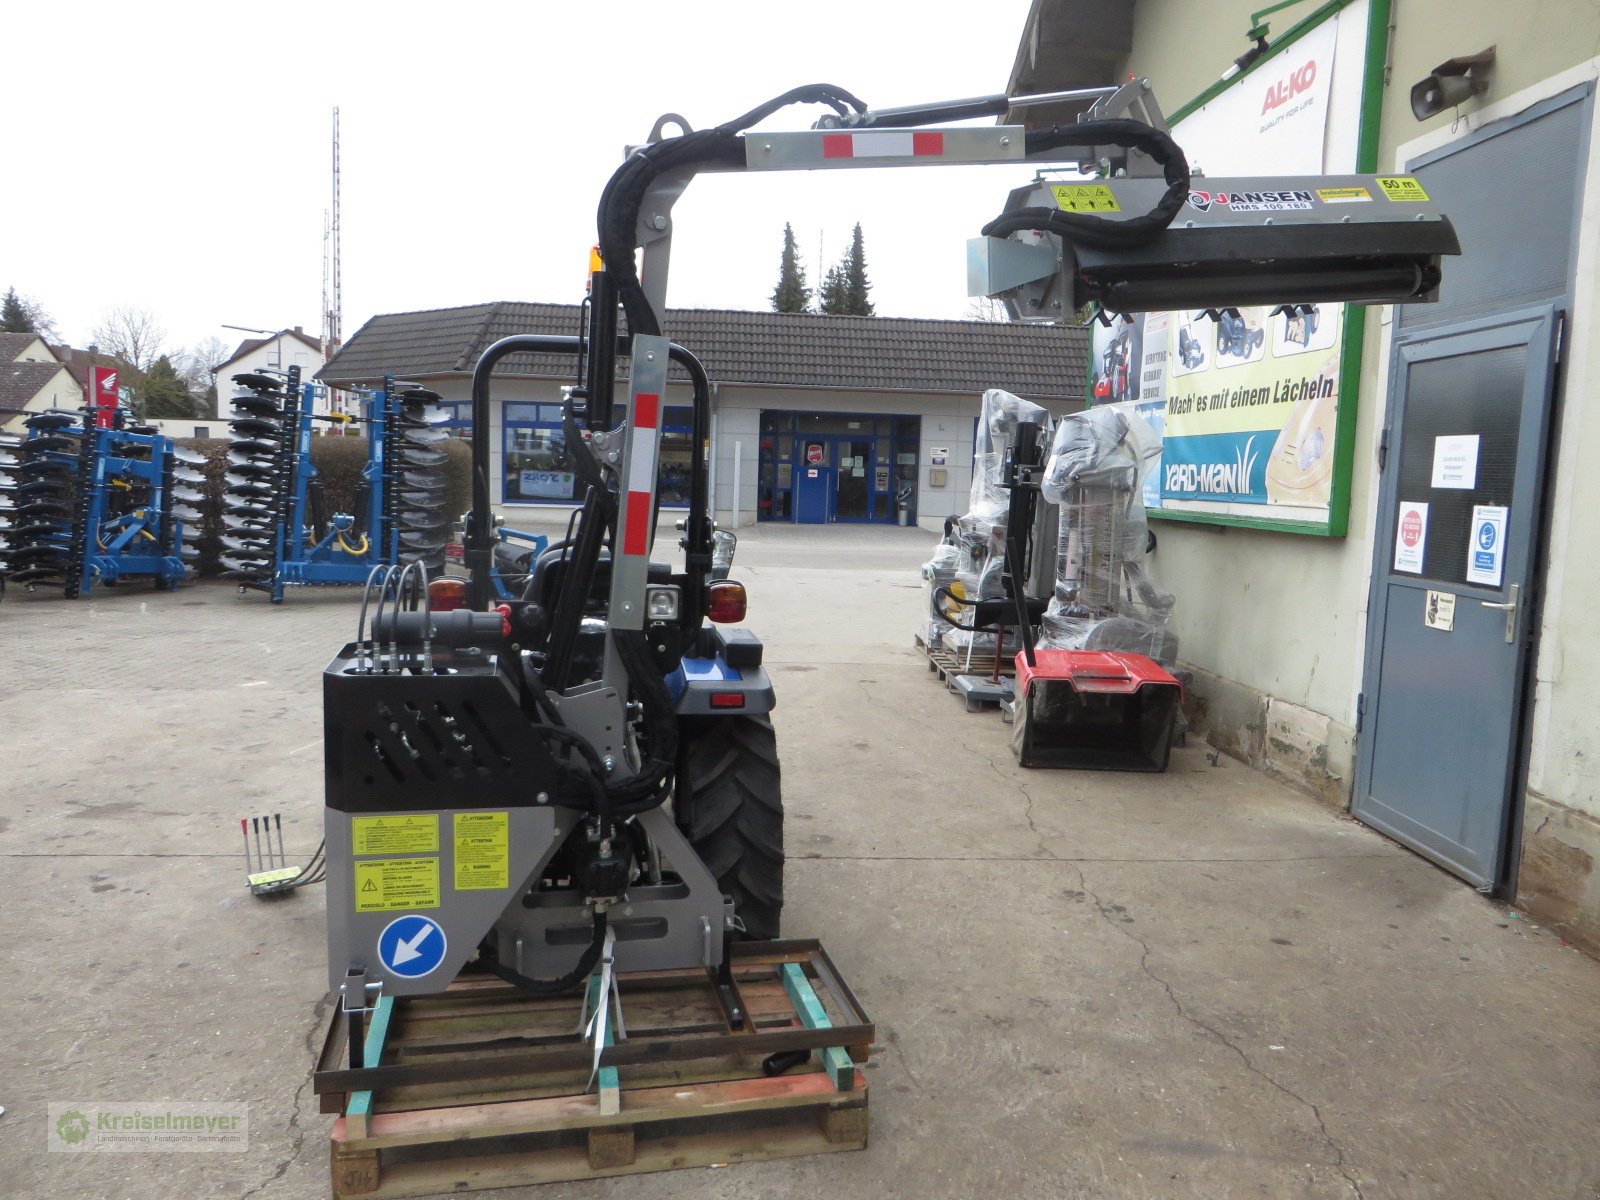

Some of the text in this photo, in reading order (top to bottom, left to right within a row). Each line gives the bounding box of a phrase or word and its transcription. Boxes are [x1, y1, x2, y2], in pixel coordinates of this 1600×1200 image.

[1261, 60, 1317, 116] AL-KO
[1260, 97, 1314, 133] QUALITY FOR LIFE
[1382, 180, 1400, 188] 50
[1214, 191, 1313, 204] JANSEN
[1143, 386, 1160, 399] SERVICE
[1168, 392, 1196, 415] Mach'
[1197, 397, 1207, 412] es
[1209, 389, 1230, 411] mit
[1230, 386, 1271, 408] einem
[1272, 374, 1334, 403] Lächeln
